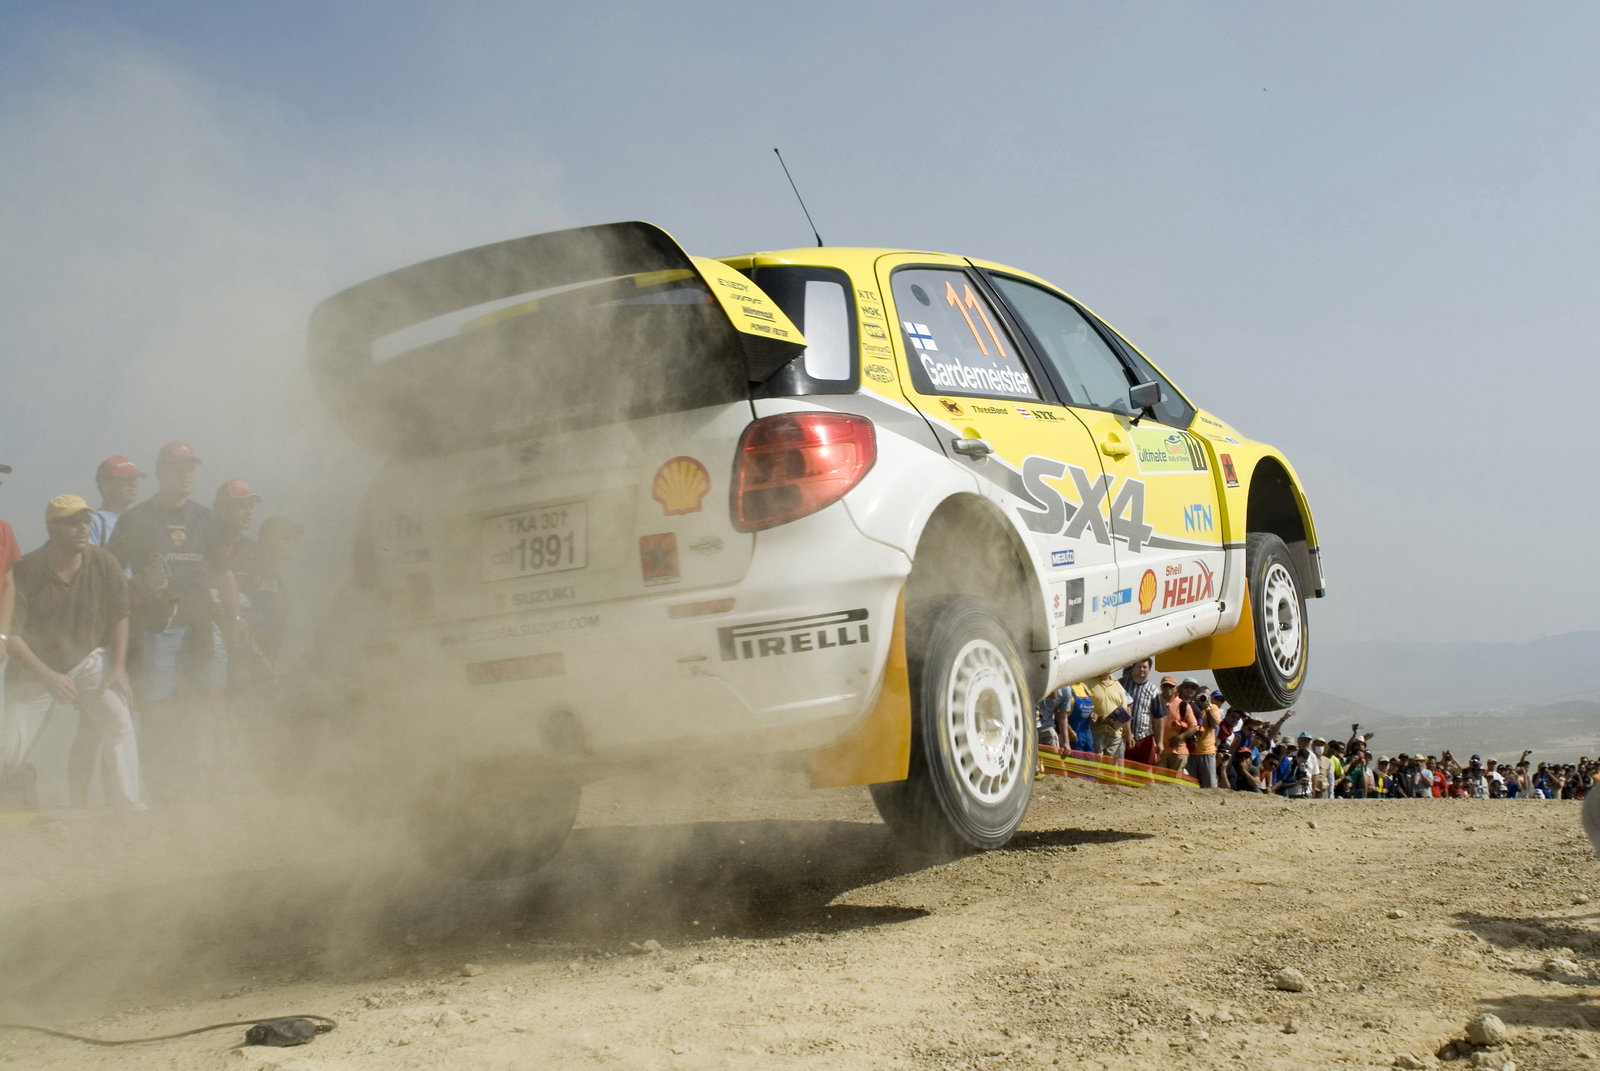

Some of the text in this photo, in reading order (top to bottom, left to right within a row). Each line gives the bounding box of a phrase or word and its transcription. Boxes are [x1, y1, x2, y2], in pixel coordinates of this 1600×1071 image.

[717, 278, 748, 291] EXEDY
[858, 290, 878, 301] KTC
[861, 306, 882, 317] NGK
[945, 281, 1007, 358] 11
[920, 353, 1033, 394] Gardemeister
[972, 405, 1009, 415] ThreeBond
[1031, 410, 1056, 420] NYK
[1016, 454, 1153, 554] SX4
[508, 515, 537, 534] TKA
[1183, 504, 1213, 533] NTN
[516, 531, 575, 571] 1891
[1165, 564, 1183, 577] Shell
[511, 586, 576, 607] SUZUKI
[1162, 571, 1214, 610] HELIX
[717, 608, 869, 662] PIRELLI
